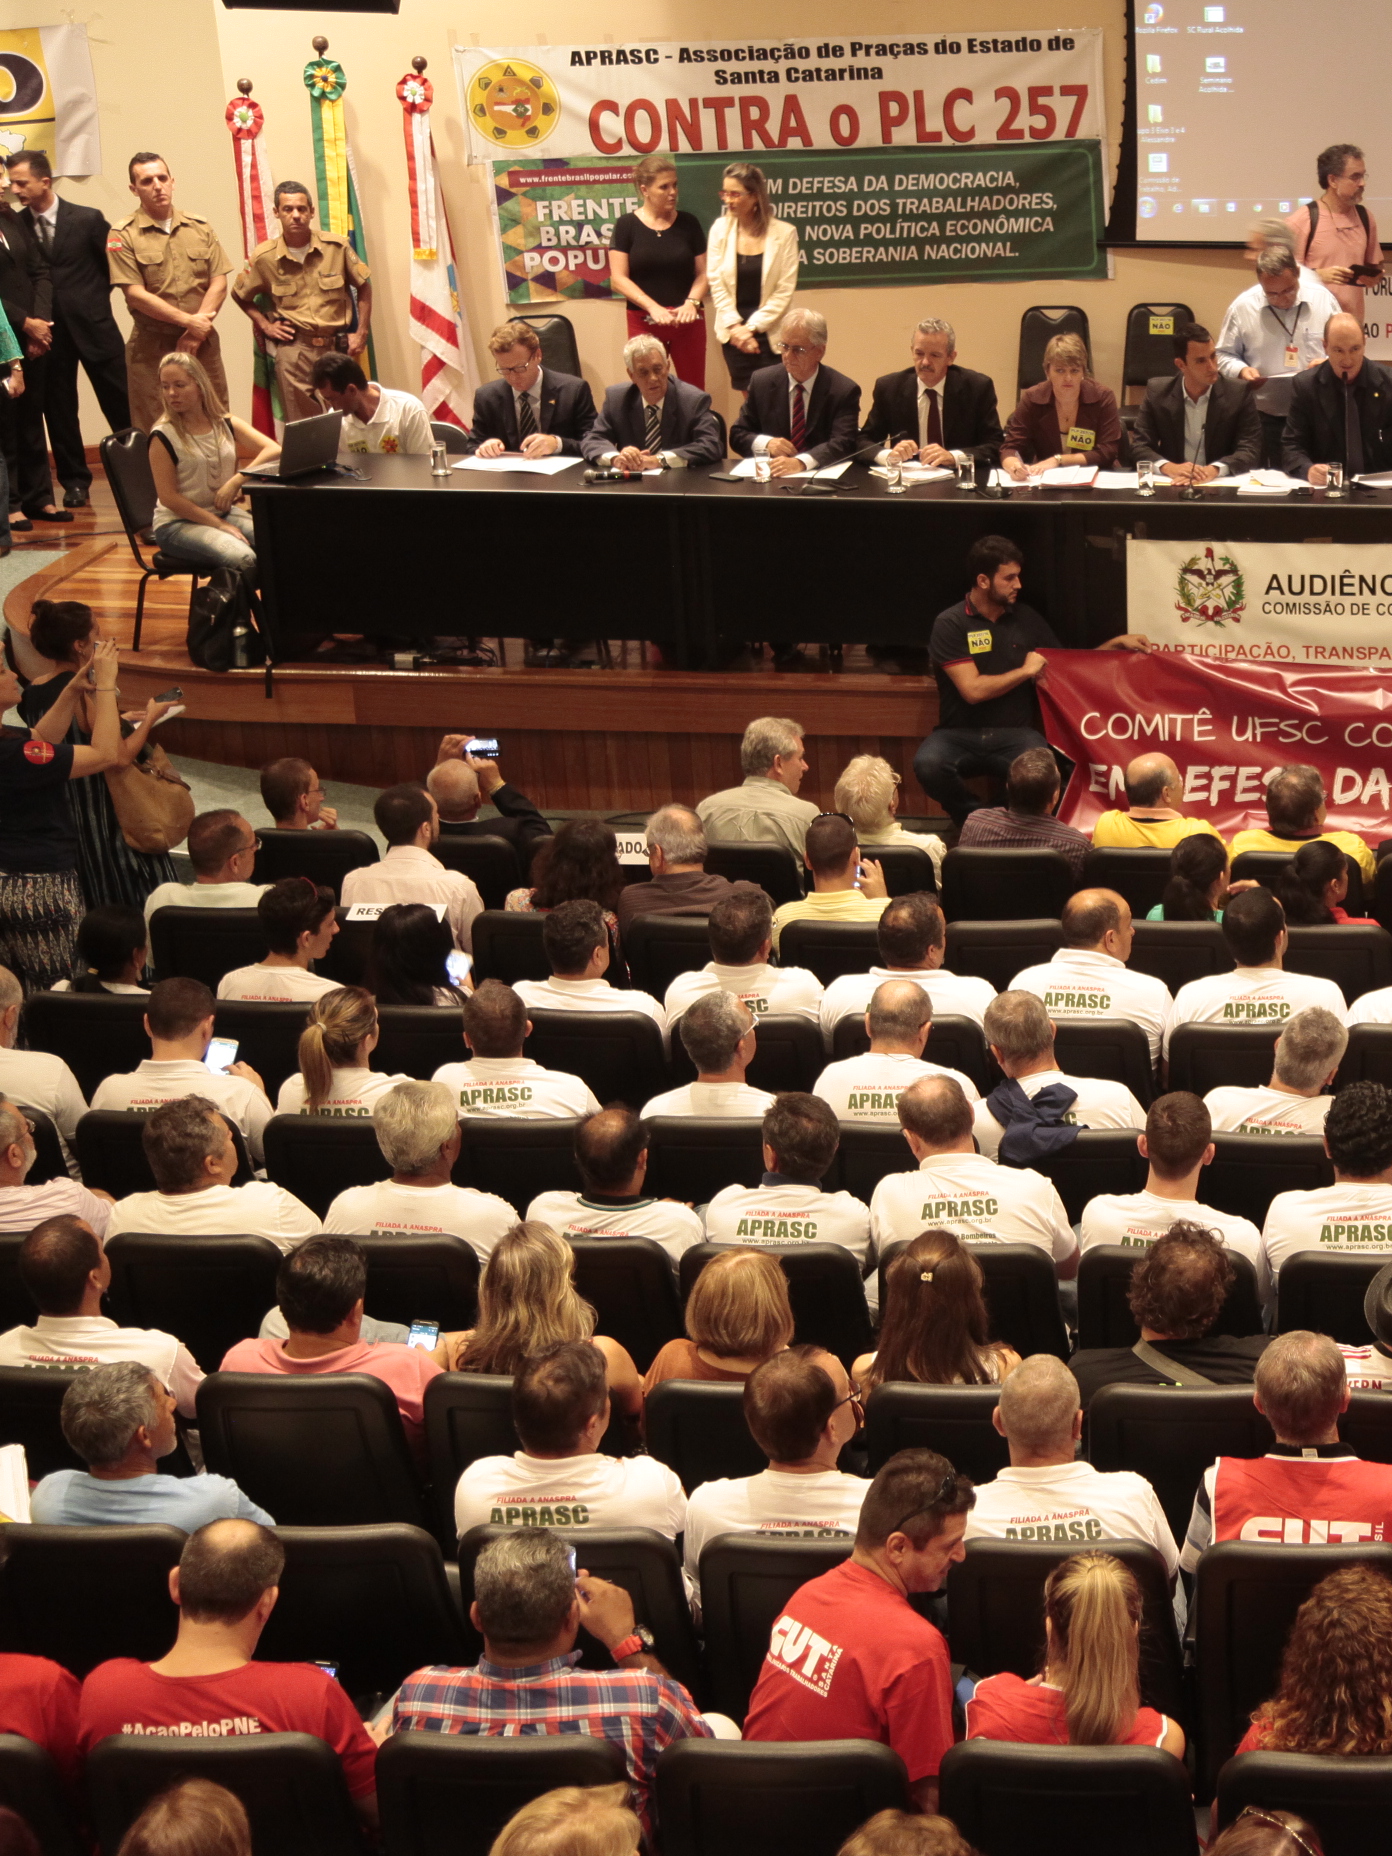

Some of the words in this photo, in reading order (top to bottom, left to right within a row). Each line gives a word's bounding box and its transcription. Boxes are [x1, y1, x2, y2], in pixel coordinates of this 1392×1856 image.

[570, 48, 659, 67] APRASC
[678, 42, 811, 64] Associação
[816, 42, 844, 59] de
[850, 40, 928, 60] Praças
[933, 39, 961, 55] do
[967, 36, 1042, 54] Estado
[1047, 35, 1075, 51] de
[714, 67, 780, 86] Santa
[785, 65, 883, 83] Catarina
[588, 93, 814, 155] CONTRA
[878, 87, 976, 144] PLC
[994, 84, 1089, 141] 257
[788, 176, 858, 194] DEFESA
[863, 175, 889, 192] DA
[894, 170, 1020, 191] DEMOCRACIA,
[536, 197, 639, 222] FRENTE
[853, 200, 891, 216] DOS
[896, 193, 1057, 215] TRABALHADORES,
[540, 223, 615, 247] BRAS
[805, 224, 854, 241] NOVA
[859, 219, 940, 239] POLÍTICA
[946, 215, 1054, 236] ECONÔMICA
[524, 250, 607, 273] POPU
[812, 245, 918, 265] SOBERANIA
[924, 242, 1019, 260] NACIONAL.
[1152, 322, 1170, 330] NÃO
[1070, 434, 1091, 445] NÃO
[1262, 599, 1345, 616] COMISSÃO
[1350, 602, 1371, 616] DE
[971, 637, 990, 648] NÃO
[1080, 708, 1216, 741] COMITÊ
[1231, 715, 1328, 744] UFSC
[1333, 767, 1392, 810] DA
[1044, 992, 1111, 1009] APRASC
[1223, 1003, 1290, 1018] APRASC
[460, 1086, 532, 1106] APRASC
[921, 1198, 998, 1220] APRASC
[736, 1219, 817, 1239] APRASC
[1326, 1243, 1392, 1251] www.aprasc.org.br
[490, 1504, 590, 1527] APRASC
[1005, 1519, 1102, 1540] APRASC
[768, 1615, 832, 1678] CUT
[824, 1648, 844, 1691] CATARINA
